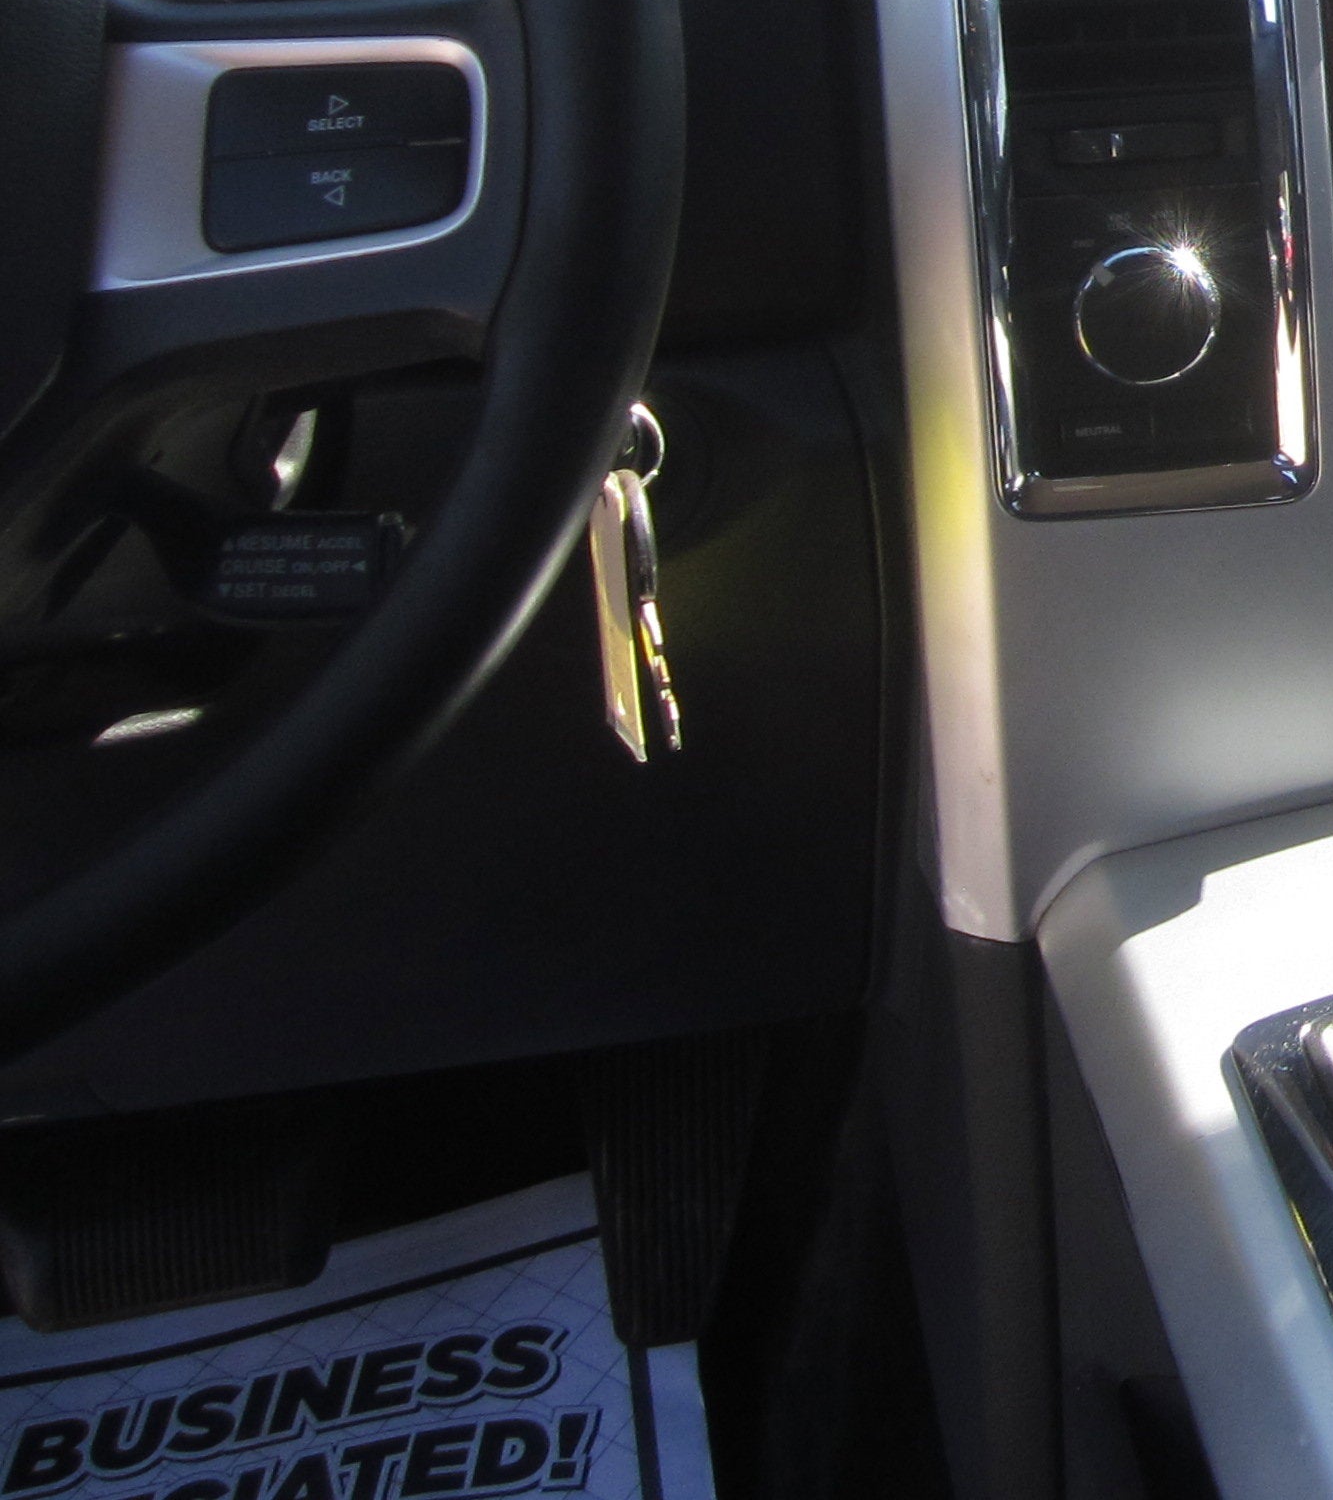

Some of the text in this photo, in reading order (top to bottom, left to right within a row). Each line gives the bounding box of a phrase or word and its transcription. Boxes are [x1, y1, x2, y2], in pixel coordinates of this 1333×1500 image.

[307, 115, 365, 131] SELECT
[310, 169, 353, 184] BACK
[237, 535, 314, 551] RESUME
[220, 558, 287, 575] CRUISE
[233, 582, 267, 598] SET
[3, 1325, 570, 1498] BUSINESS
